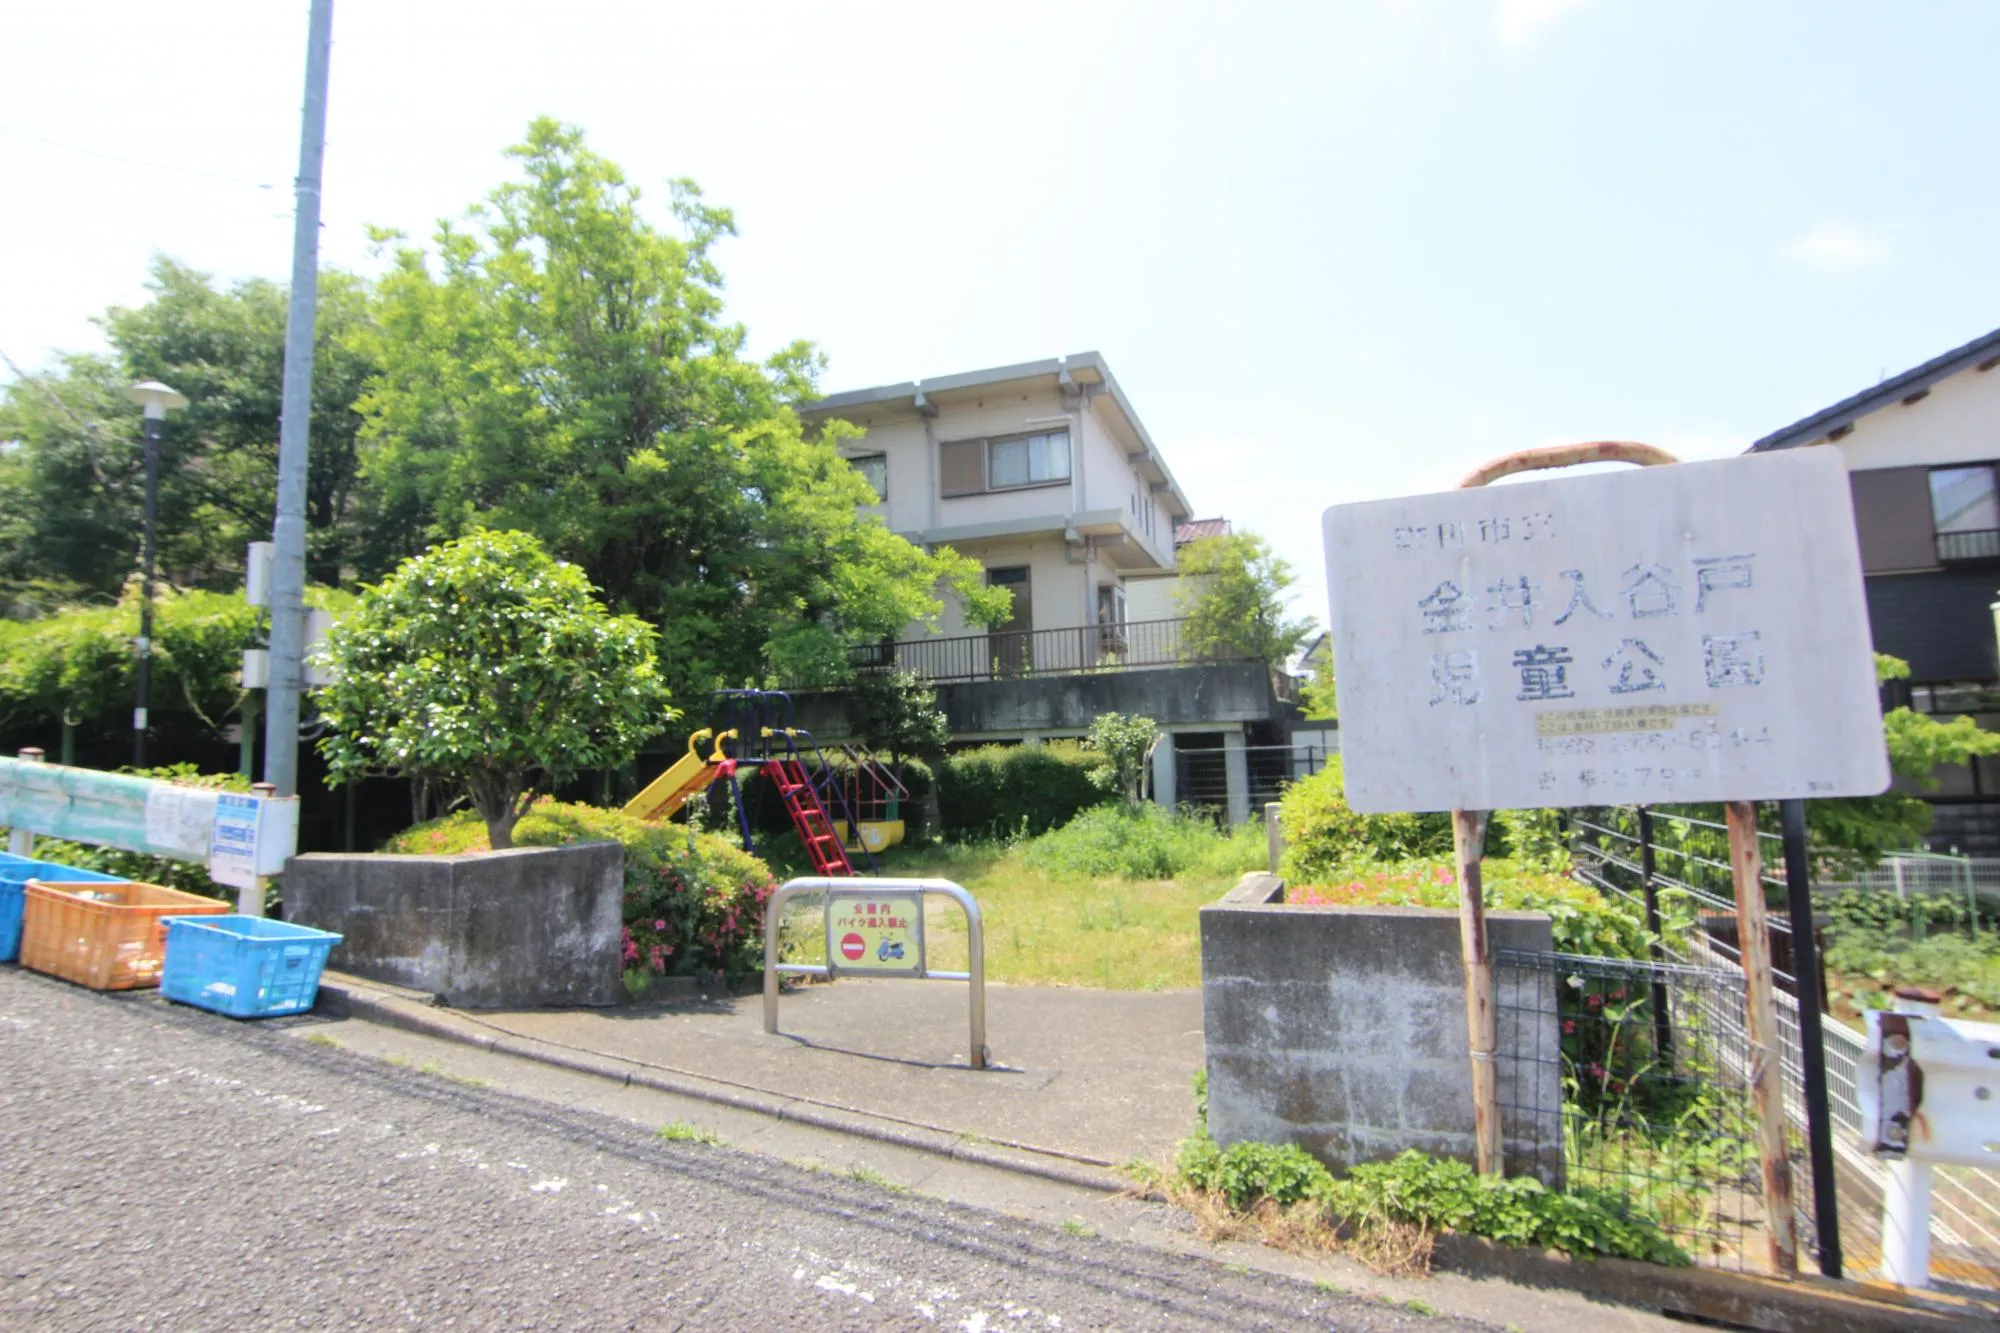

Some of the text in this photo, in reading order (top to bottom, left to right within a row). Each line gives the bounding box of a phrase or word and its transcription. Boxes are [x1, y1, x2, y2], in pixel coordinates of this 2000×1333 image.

[1418, 553, 1756, 635] 金井入谷戸
[1429, 630, 1764, 707] 児童公園
